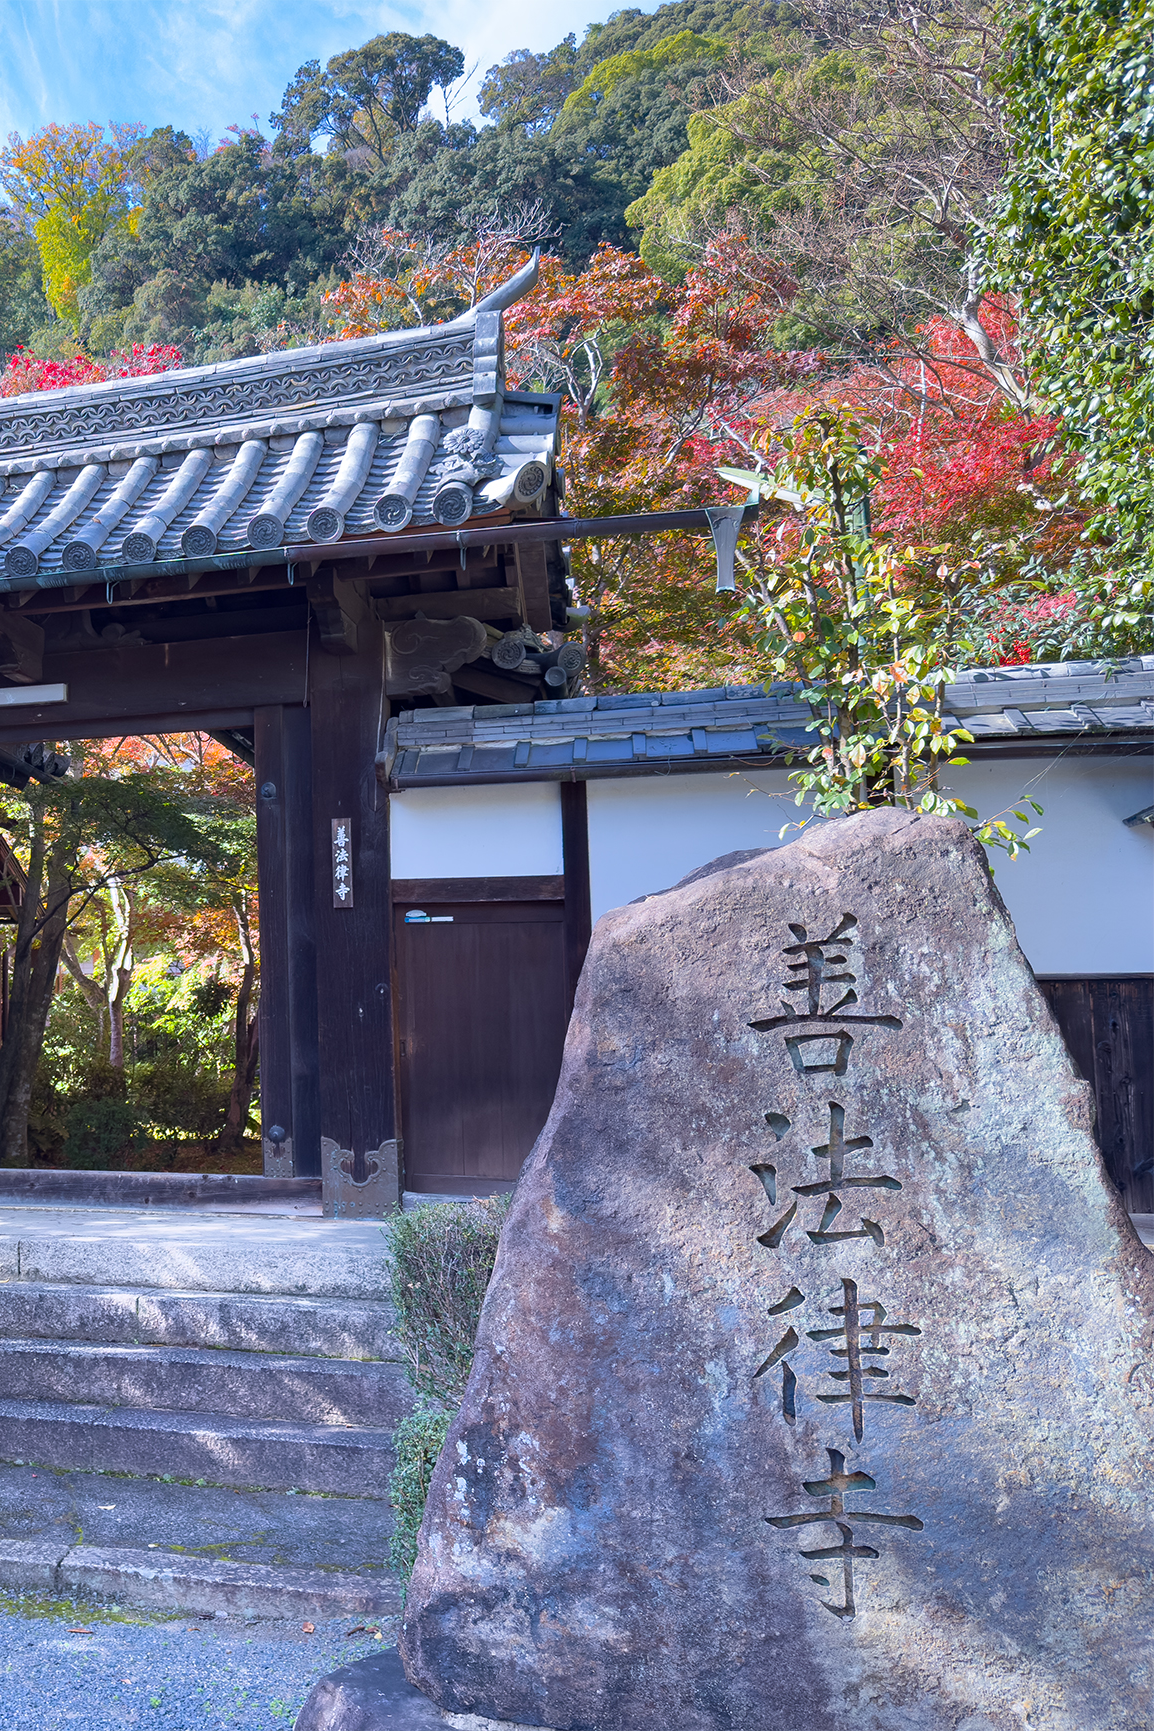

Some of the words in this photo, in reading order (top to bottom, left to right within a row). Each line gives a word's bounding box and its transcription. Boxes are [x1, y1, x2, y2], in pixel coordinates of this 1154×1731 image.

[333, 825, 350, 901] 善法律寺
[747, 912, 924, 1621] 善法律寺
